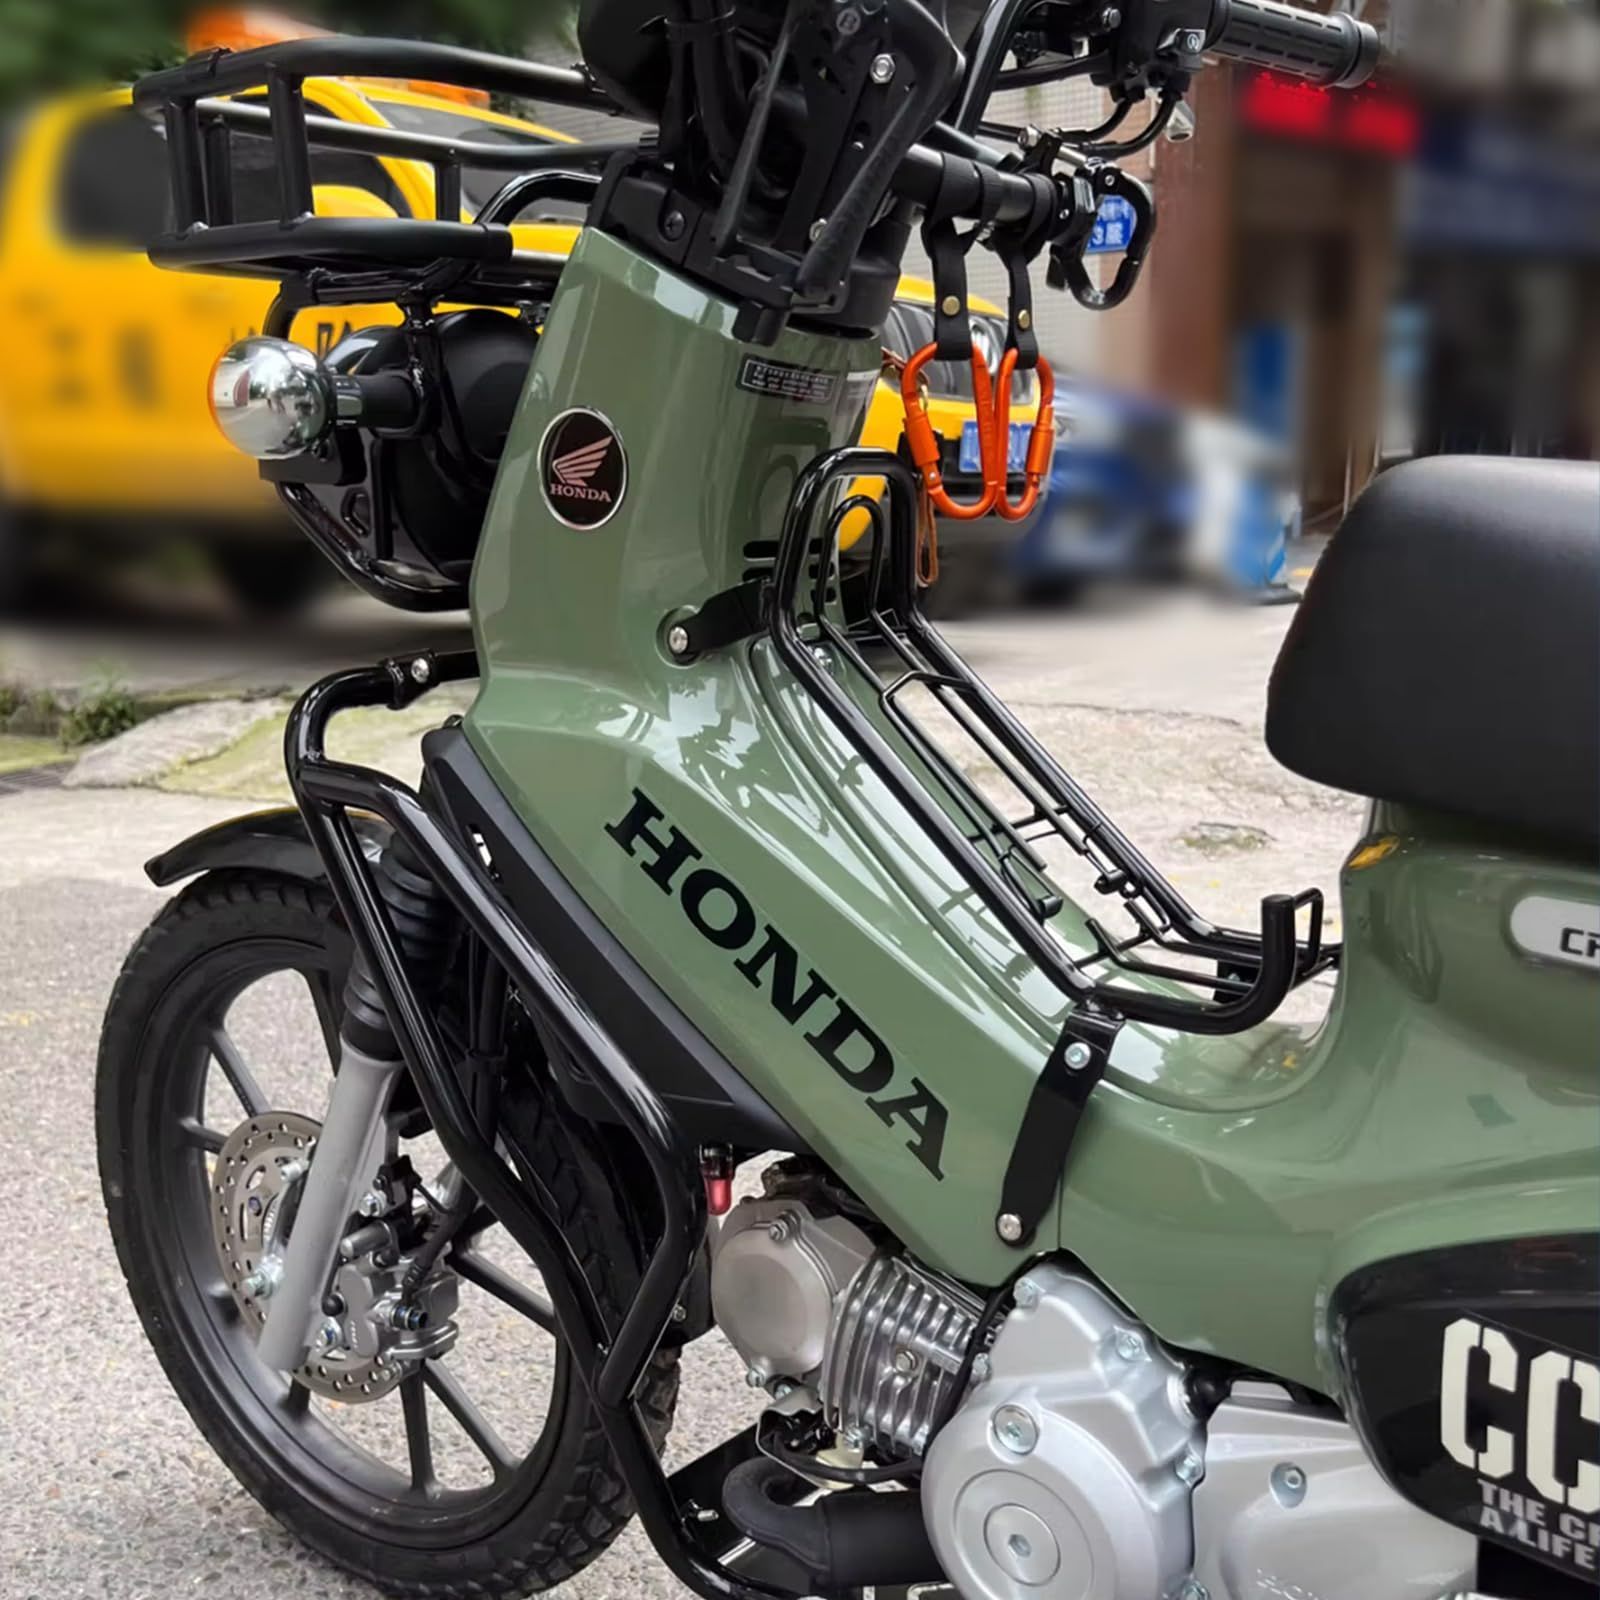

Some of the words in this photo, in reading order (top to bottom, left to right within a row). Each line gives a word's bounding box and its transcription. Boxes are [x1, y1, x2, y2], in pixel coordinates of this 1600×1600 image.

[550, 483, 612, 503] HONDA
[604, 786, 949, 1182] HONDA
[1478, 1478, 1546, 1527] THE
